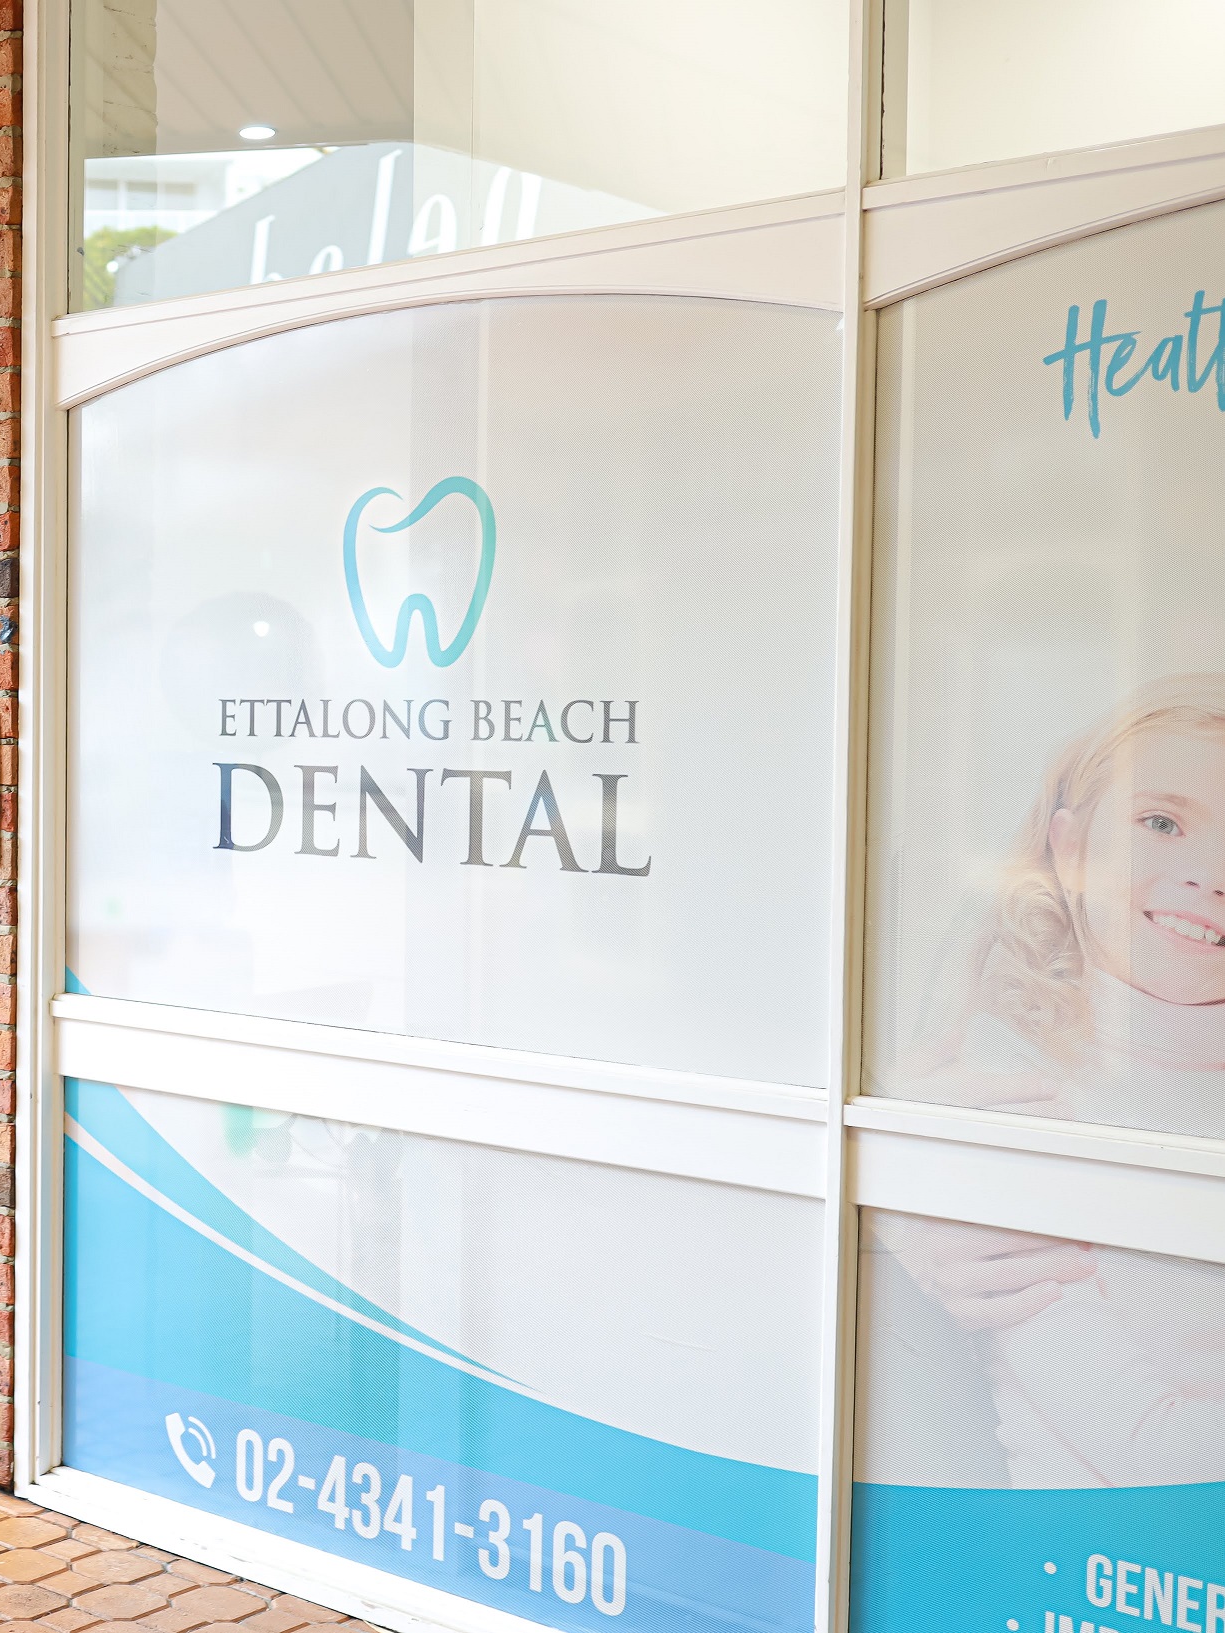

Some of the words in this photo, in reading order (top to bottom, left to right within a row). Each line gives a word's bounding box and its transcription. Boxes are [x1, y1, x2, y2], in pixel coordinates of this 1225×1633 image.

[218, 699, 452, 741] ETTALONG
[470, 699, 640, 744] BEACH
[212, 762, 652, 877] DENTAL
[235, 1428, 627, 1617] 02-4341-3160
